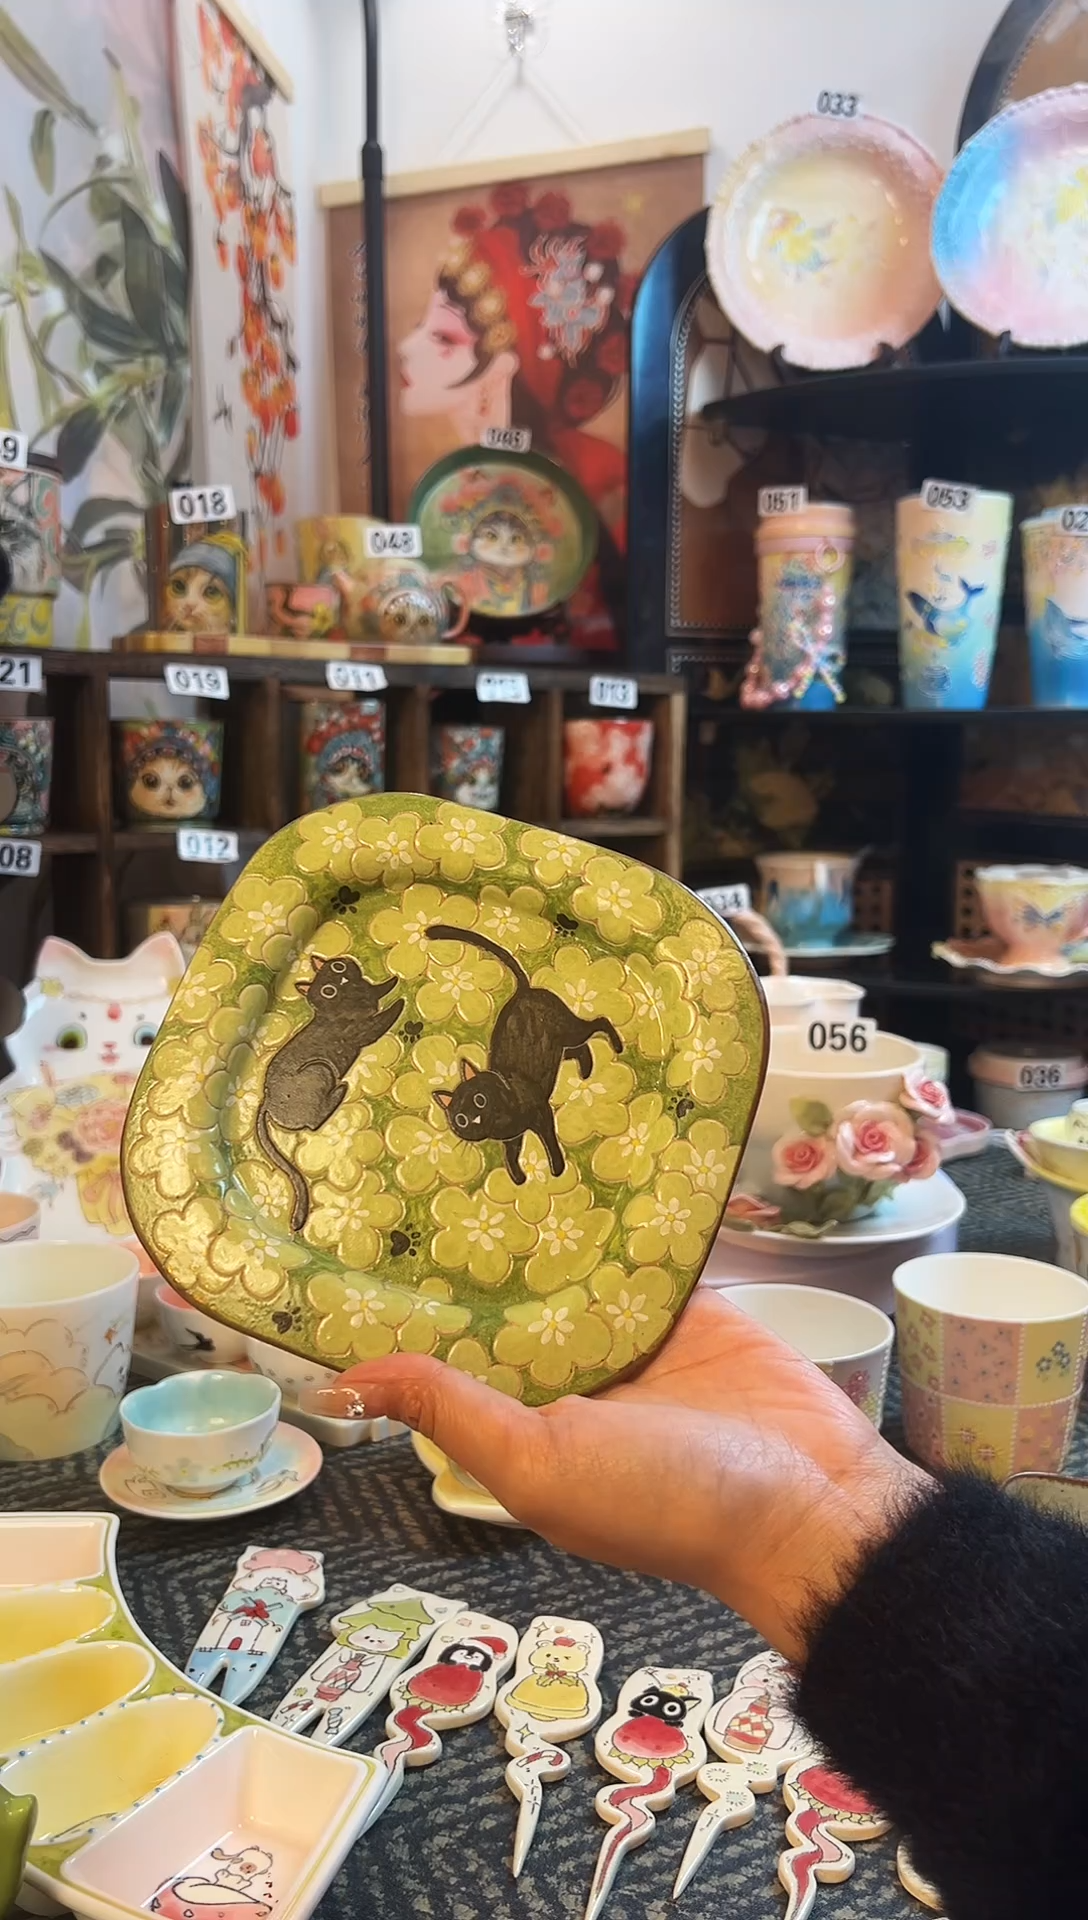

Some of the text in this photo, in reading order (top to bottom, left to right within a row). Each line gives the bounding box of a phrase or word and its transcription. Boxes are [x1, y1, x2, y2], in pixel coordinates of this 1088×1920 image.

[817, 90, 858, 117] 033
[179, 491, 226, 519] 018
[926, 485, 970, 512] 053
[175, 670, 222, 694] 019
[186, 834, 229, 858] 012
[808, 1022, 867, 1052] 056
[1019, 1064, 1061, 1089] 036
